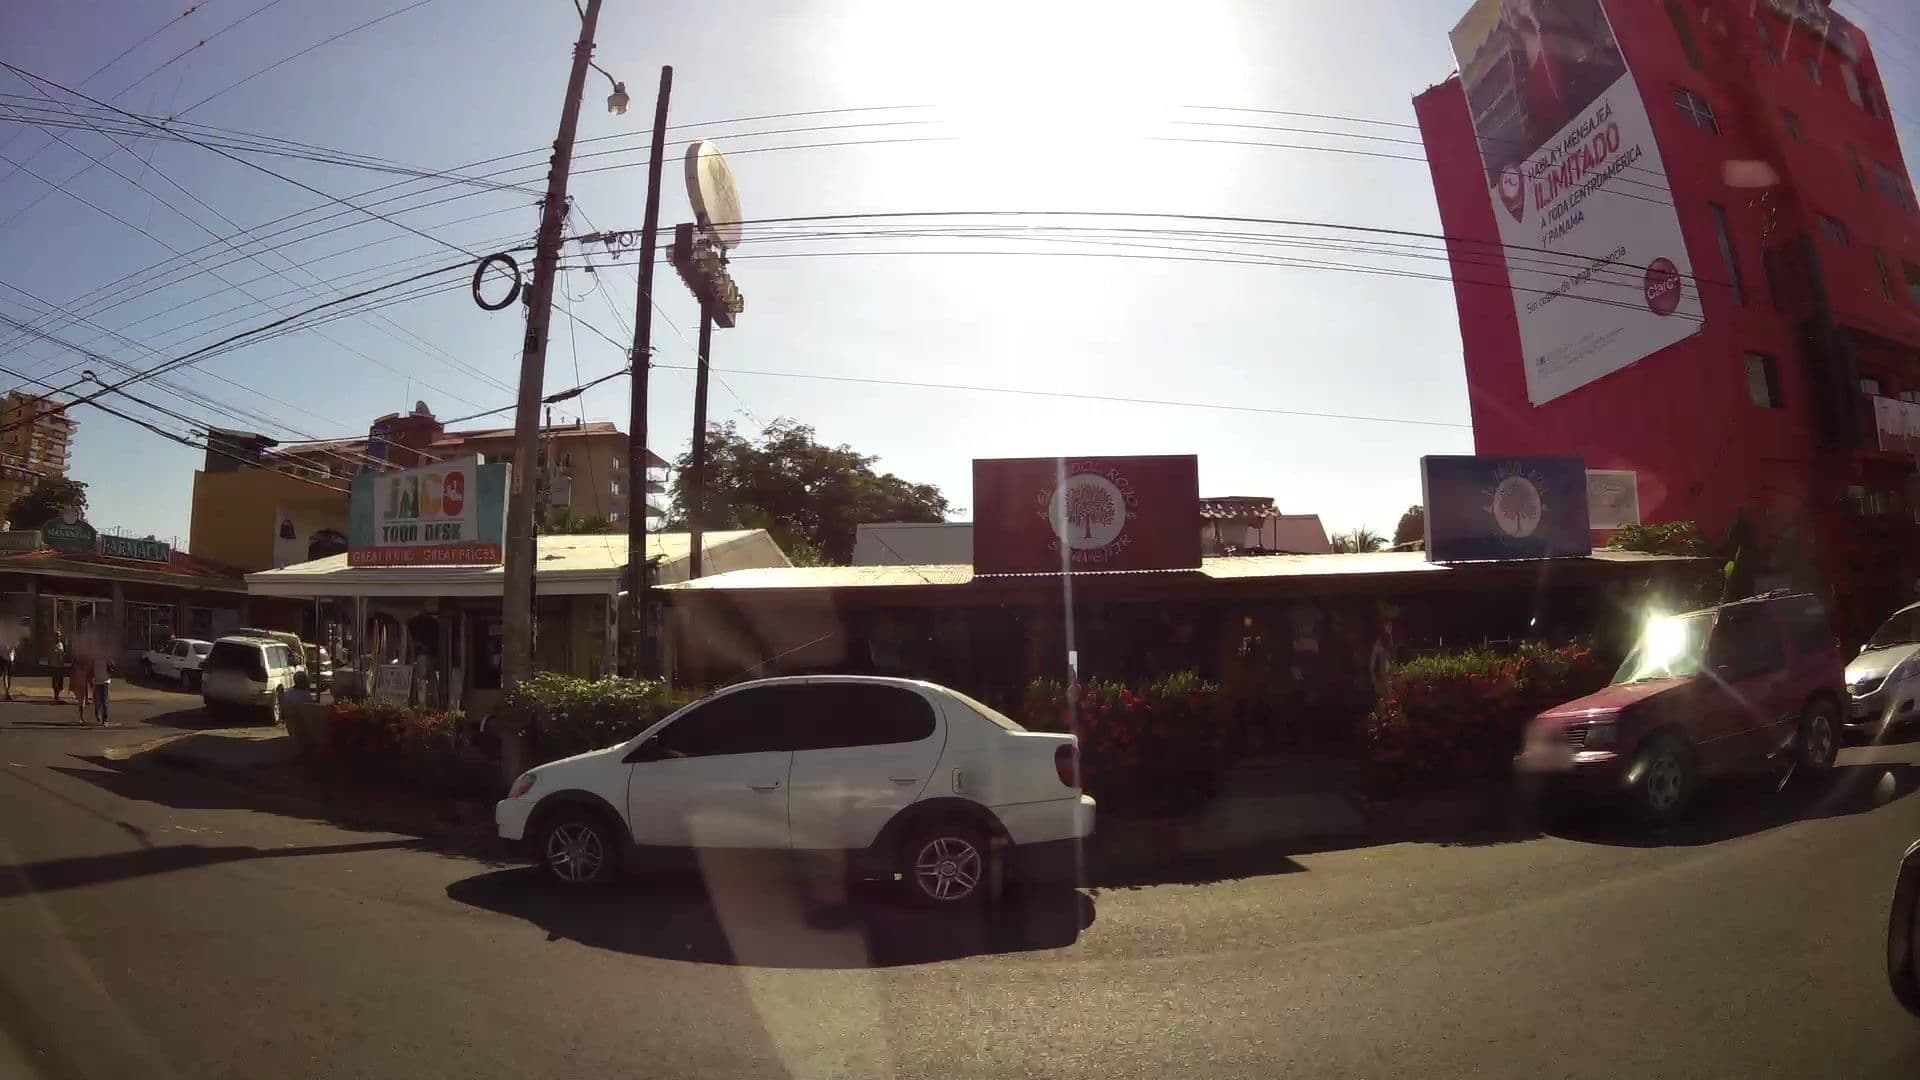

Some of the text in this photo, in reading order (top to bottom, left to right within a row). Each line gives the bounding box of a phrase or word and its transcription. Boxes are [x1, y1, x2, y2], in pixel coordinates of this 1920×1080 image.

[1534, 122, 1620, 212] ILIMITADO
[1540, 215, 1547, 230] A
[1548, 199, 1569, 225] TODA
[1647, 277, 1674, 300] Claro
[425, 522, 462, 541] DESK
